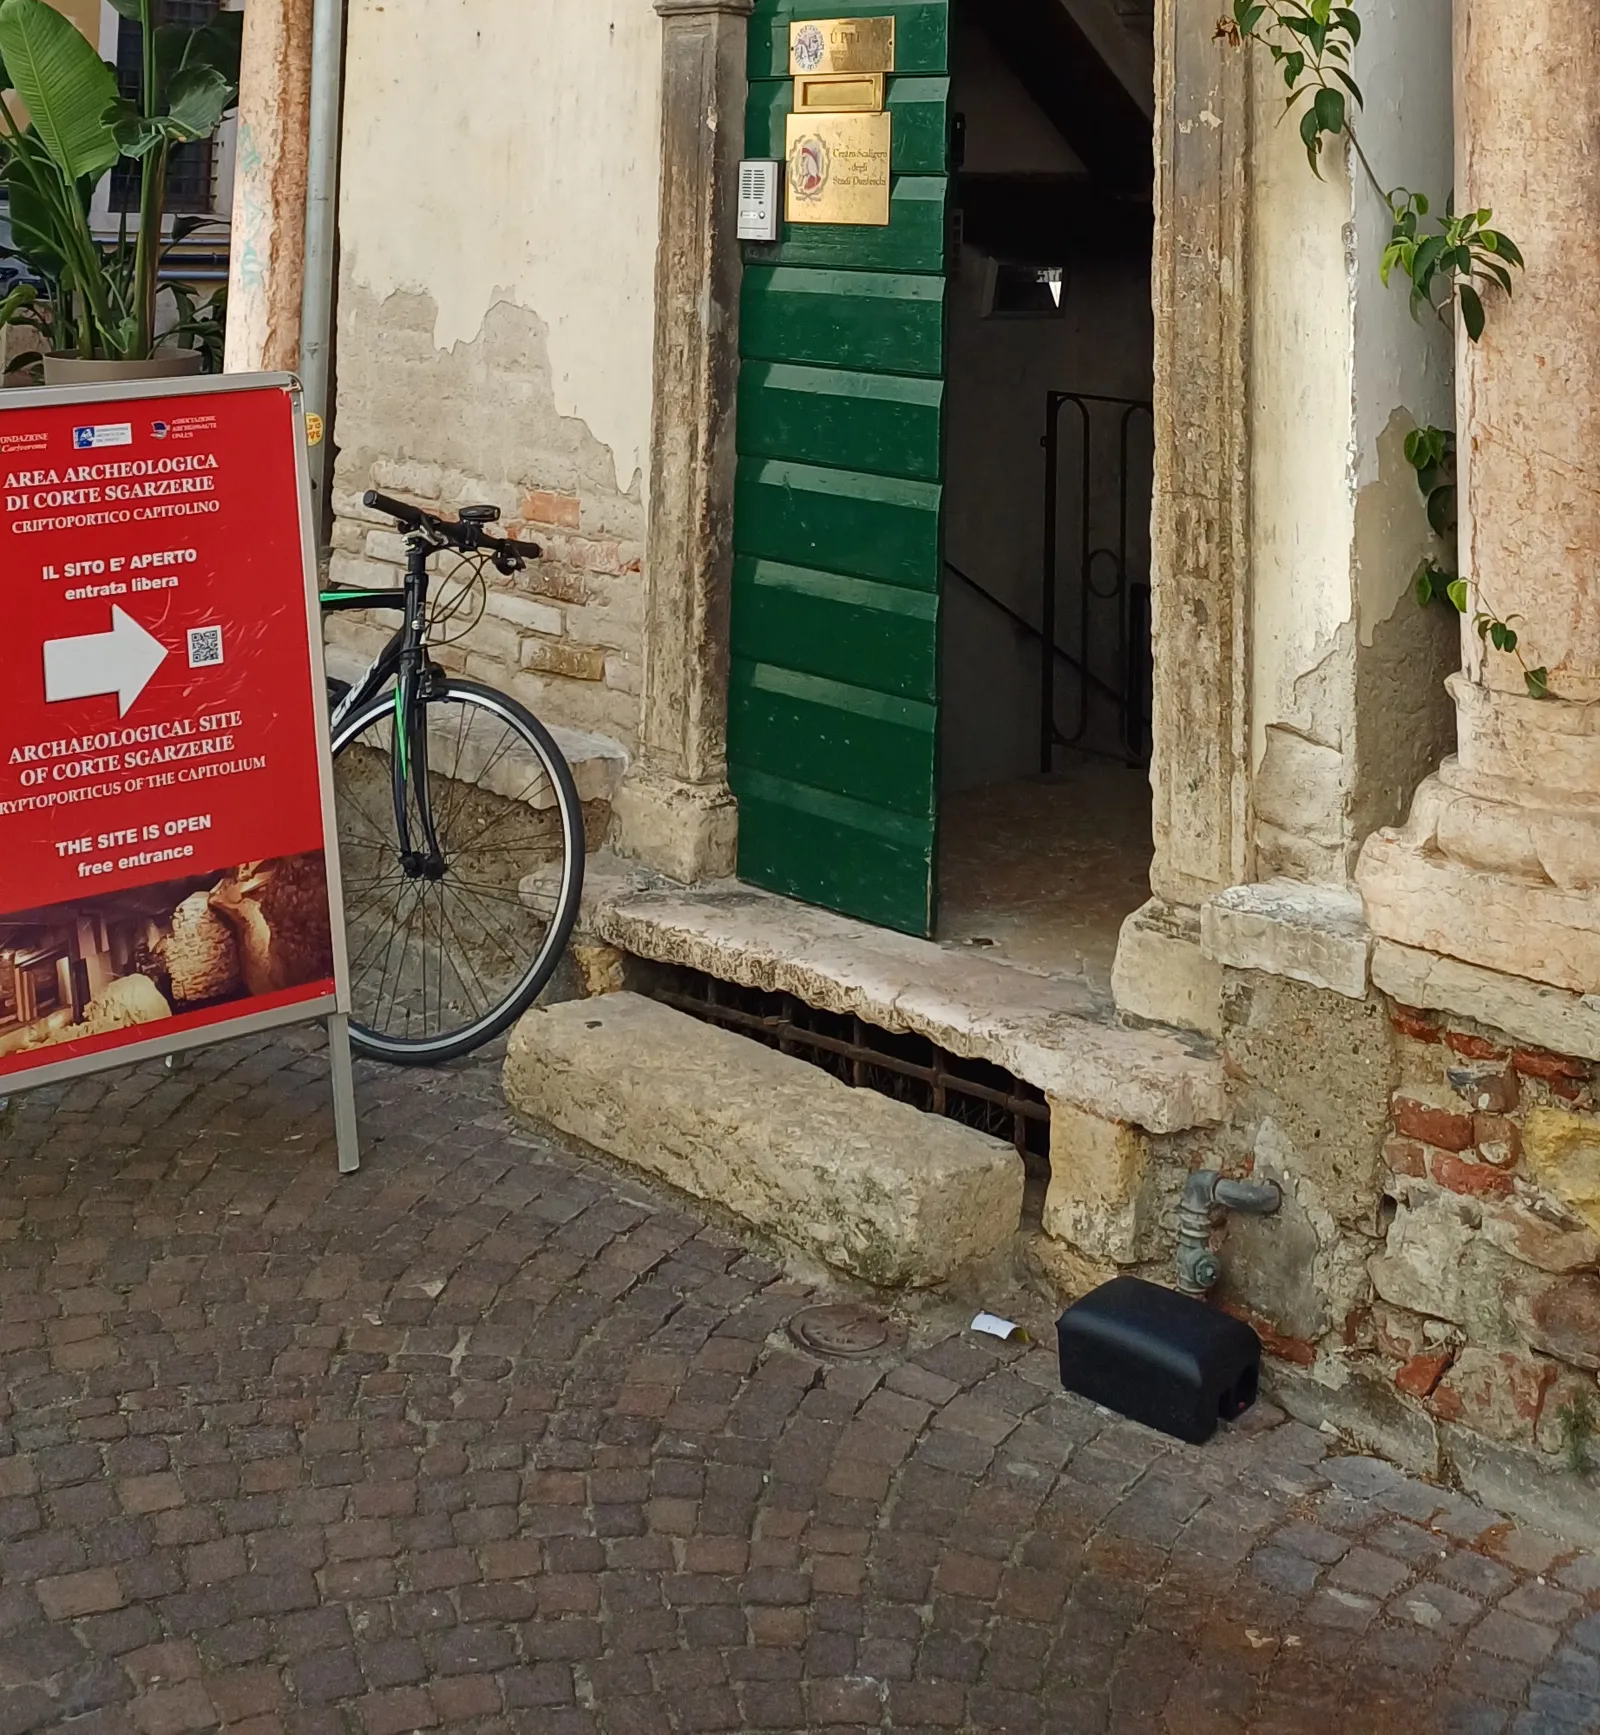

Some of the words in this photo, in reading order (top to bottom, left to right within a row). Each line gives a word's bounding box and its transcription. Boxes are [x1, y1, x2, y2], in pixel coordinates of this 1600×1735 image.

[0, 433, 49, 444] ONDAZIONE
[3, 470, 60, 489] AREA
[63, 453, 219, 483] ARCHEOLOGICA
[6, 495, 29, 512] DI
[33, 488, 101, 509] CORTE
[105, 475, 215, 501] SGARZERIE
[12, 509, 130, 534] CRIPTOPORTICO
[133, 500, 220, 521] CAPITOLINO
[42, 566, 60, 580] IL
[64, 560, 105, 577] SITO
[130, 548, 197, 569] APERTO
[65, 582, 127, 600] entrata
[132, 575, 179, 592] libera
[8, 719, 196, 765] ARCHAEOLOGICAL
[199, 710, 243, 732] SITE
[19, 768, 49, 787] OF
[52, 754, 121, 782] CORTE
[124, 734, 235, 769] SGARZERIE
[0, 781, 122, 815] RYPTOPORTICUS
[125, 777, 145, 793] OF
[146, 772, 176, 789] THE
[178, 754, 267, 783] CAPITOLIUM
[55, 837, 93, 857] THE
[97, 827, 138, 850] SITE
[142, 823, 160, 840] IS
[165, 814, 212, 837] OPEN
[77, 859, 113, 878] free
[118, 843, 194, 869] entrance
